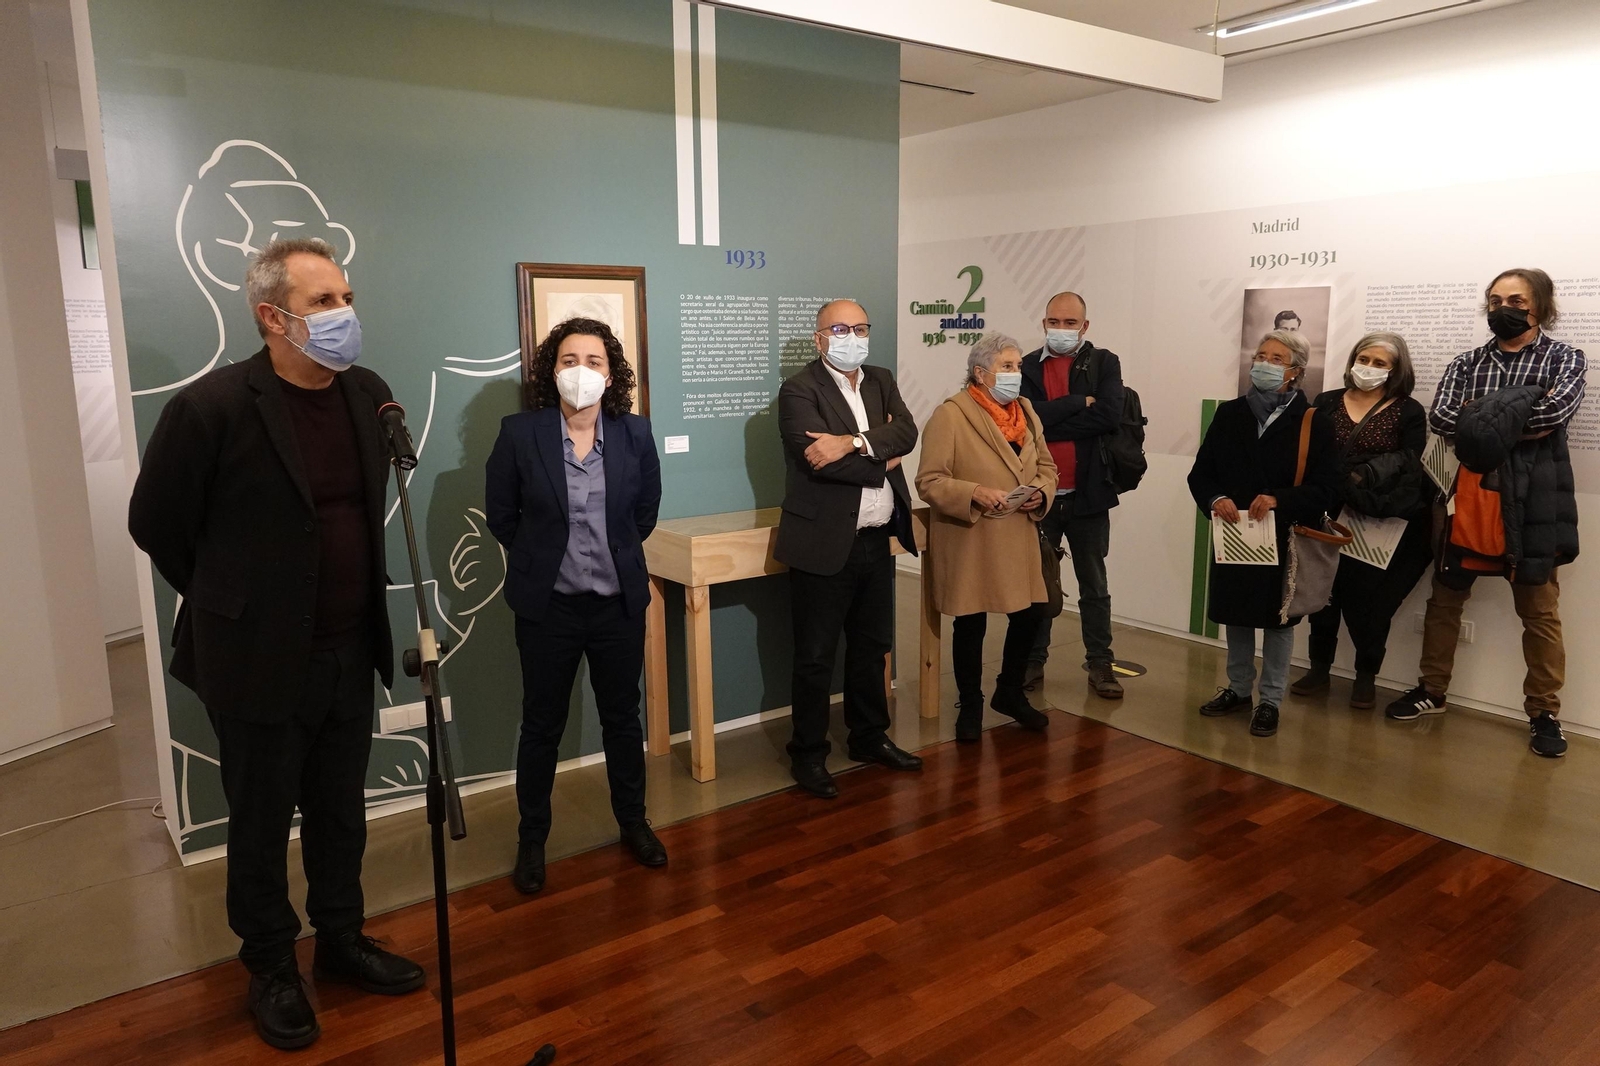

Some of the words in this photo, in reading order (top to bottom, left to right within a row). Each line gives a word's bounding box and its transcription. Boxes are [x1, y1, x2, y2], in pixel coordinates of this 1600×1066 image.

[1251, 217, 1300, 235] Madrid
[725, 249, 766, 270] 1933
[956, 265, 985, 313] 2
[910, 299, 955, 315] Camiño
[940, 313, 985, 329] andado
[922, 329, 946, 347] 1936
